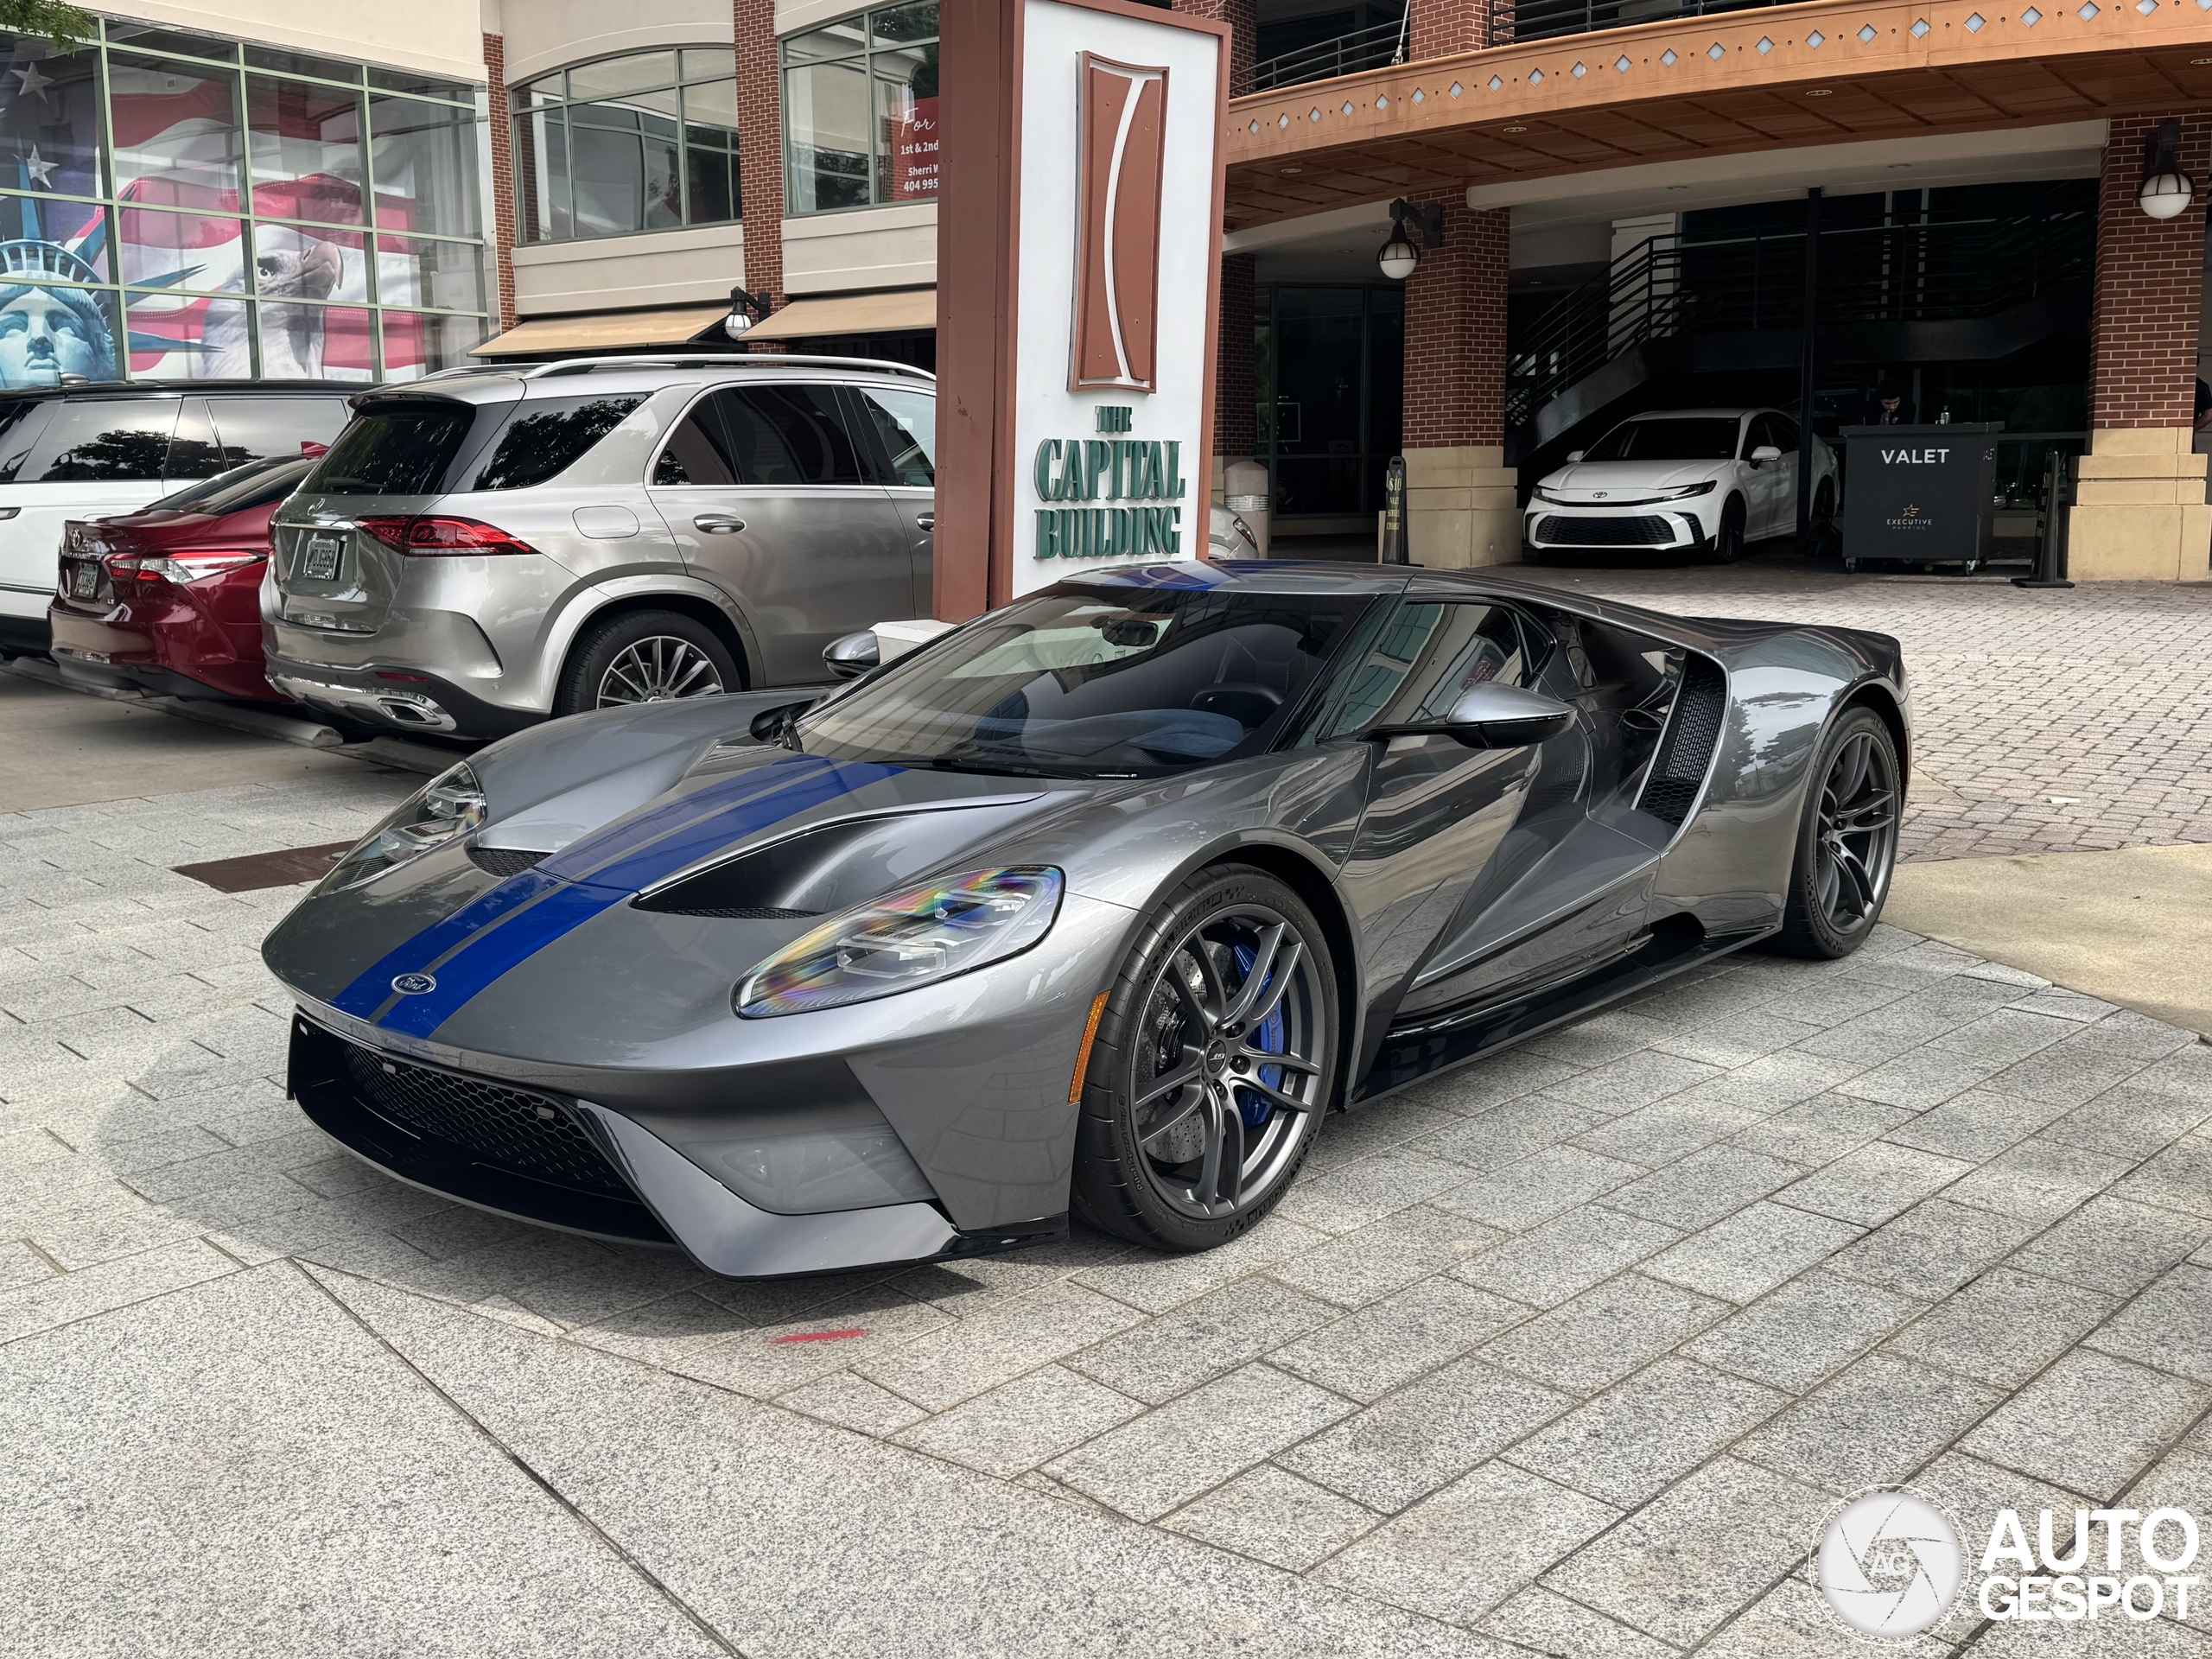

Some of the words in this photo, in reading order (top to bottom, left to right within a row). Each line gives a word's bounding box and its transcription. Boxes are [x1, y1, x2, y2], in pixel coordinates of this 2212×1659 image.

[901, 107, 935, 137] For
[900, 144, 913, 155] 1st
[915, 143, 922, 153] &
[924, 140, 938, 152] 2nd
[908, 164, 931, 176] Sherri
[904, 181, 920, 192] 404
[922, 178, 938, 189] 995
[1095, 405, 1132, 432] THE
[1881, 448, 1949, 465] VALET
[1033, 438, 1186, 501] CAPITAL
[1033, 505, 1182, 559] BUILDING
